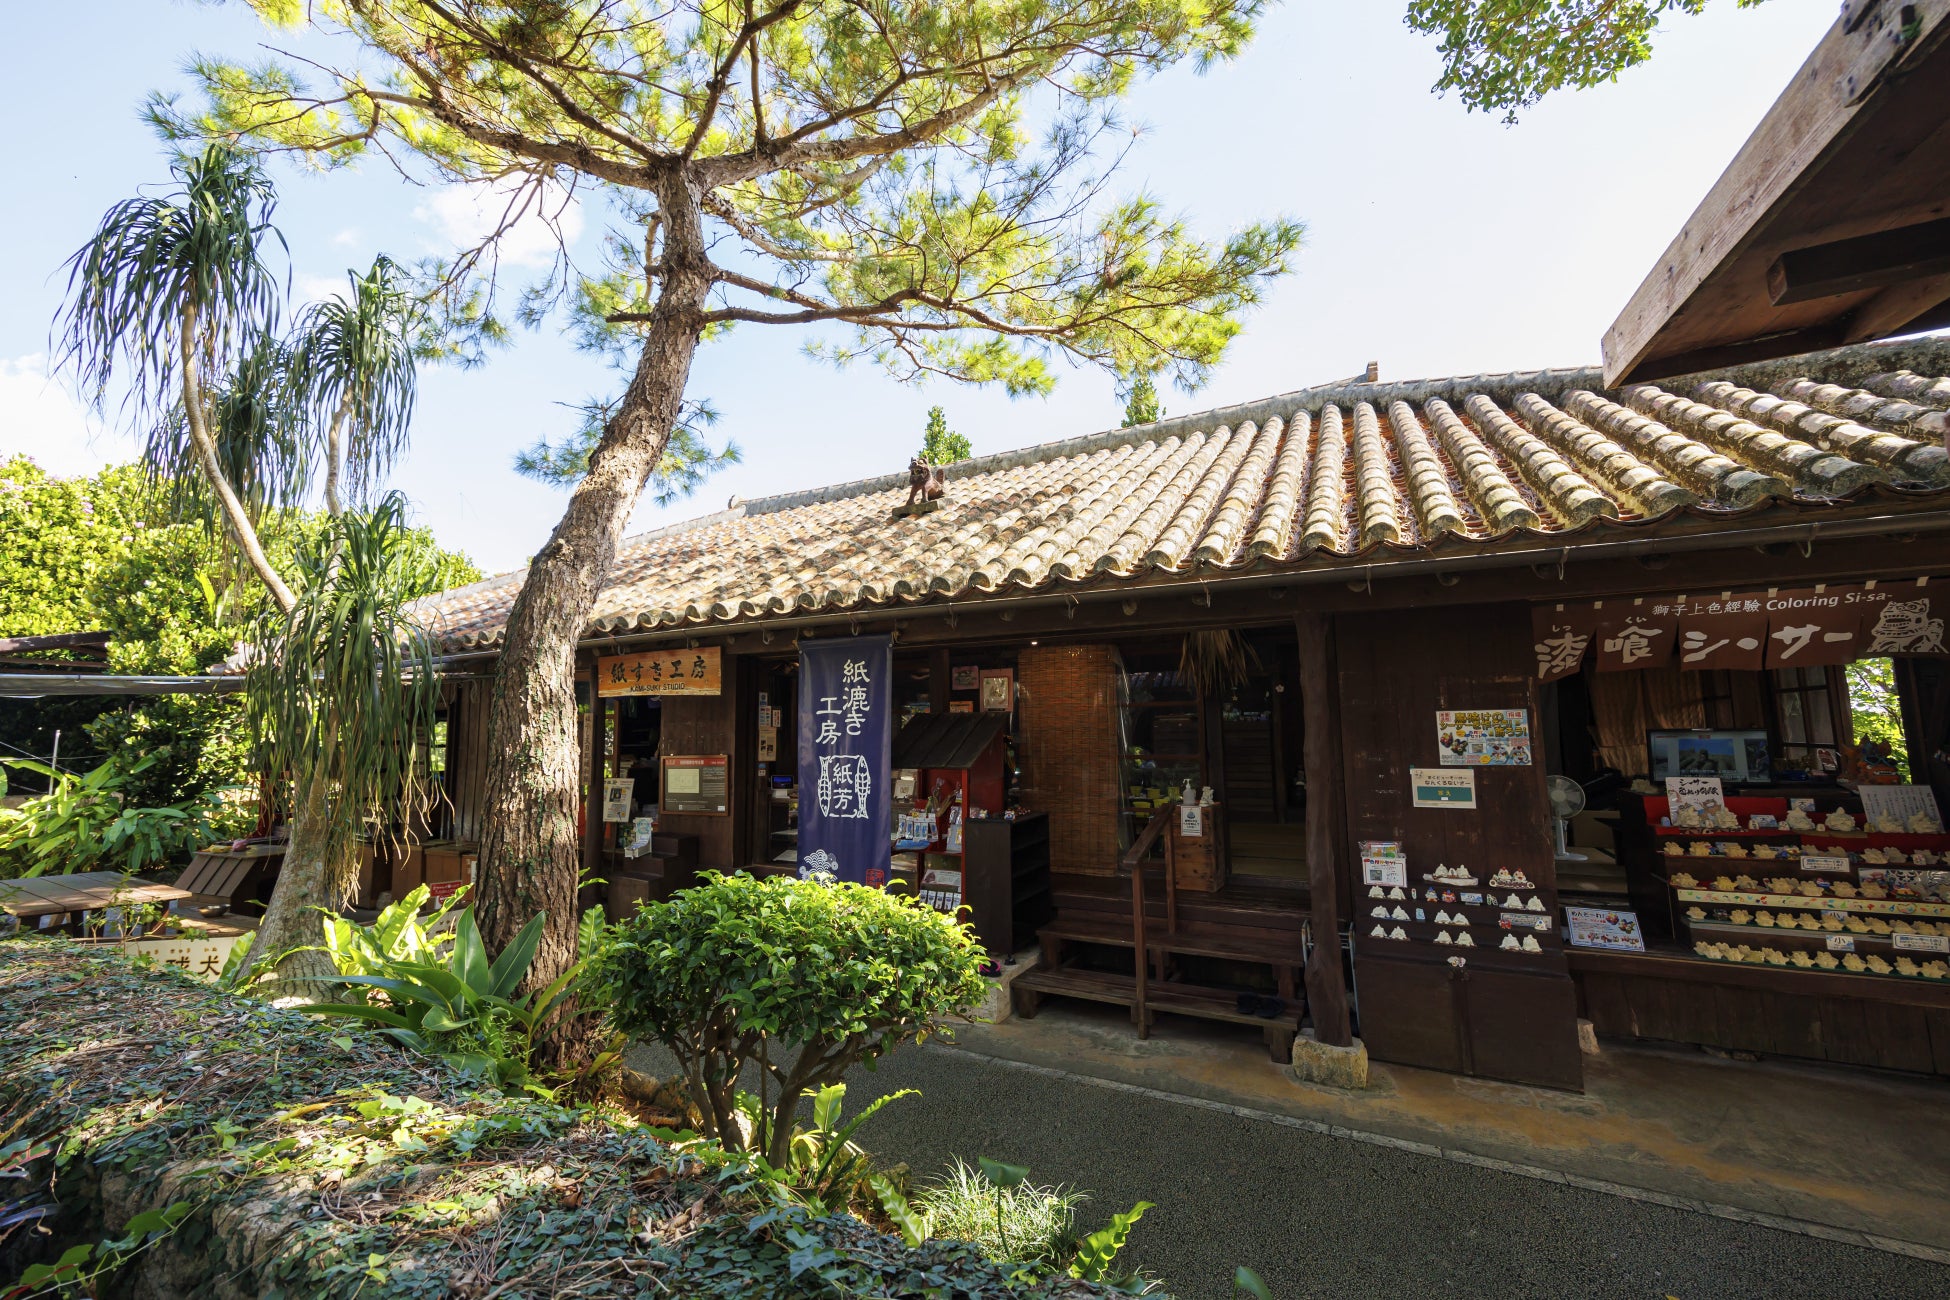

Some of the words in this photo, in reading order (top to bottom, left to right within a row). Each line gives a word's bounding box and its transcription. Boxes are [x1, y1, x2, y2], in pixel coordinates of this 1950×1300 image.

[1652, 599, 1761, 616] 獅子上色經驗
[1766, 594, 1839, 611] Coloring
[1844, 592, 1893, 604] Si-sa-
[1625, 616, 1647, 624] くい
[663, 682, 685, 690] STUDIO
[842, 658, 870, 736] 紙漉き
[815, 697, 843, 745] 工房
[832, 762, 853, 811] 紙芳
[1679, 778, 1710, 787] シーサー
